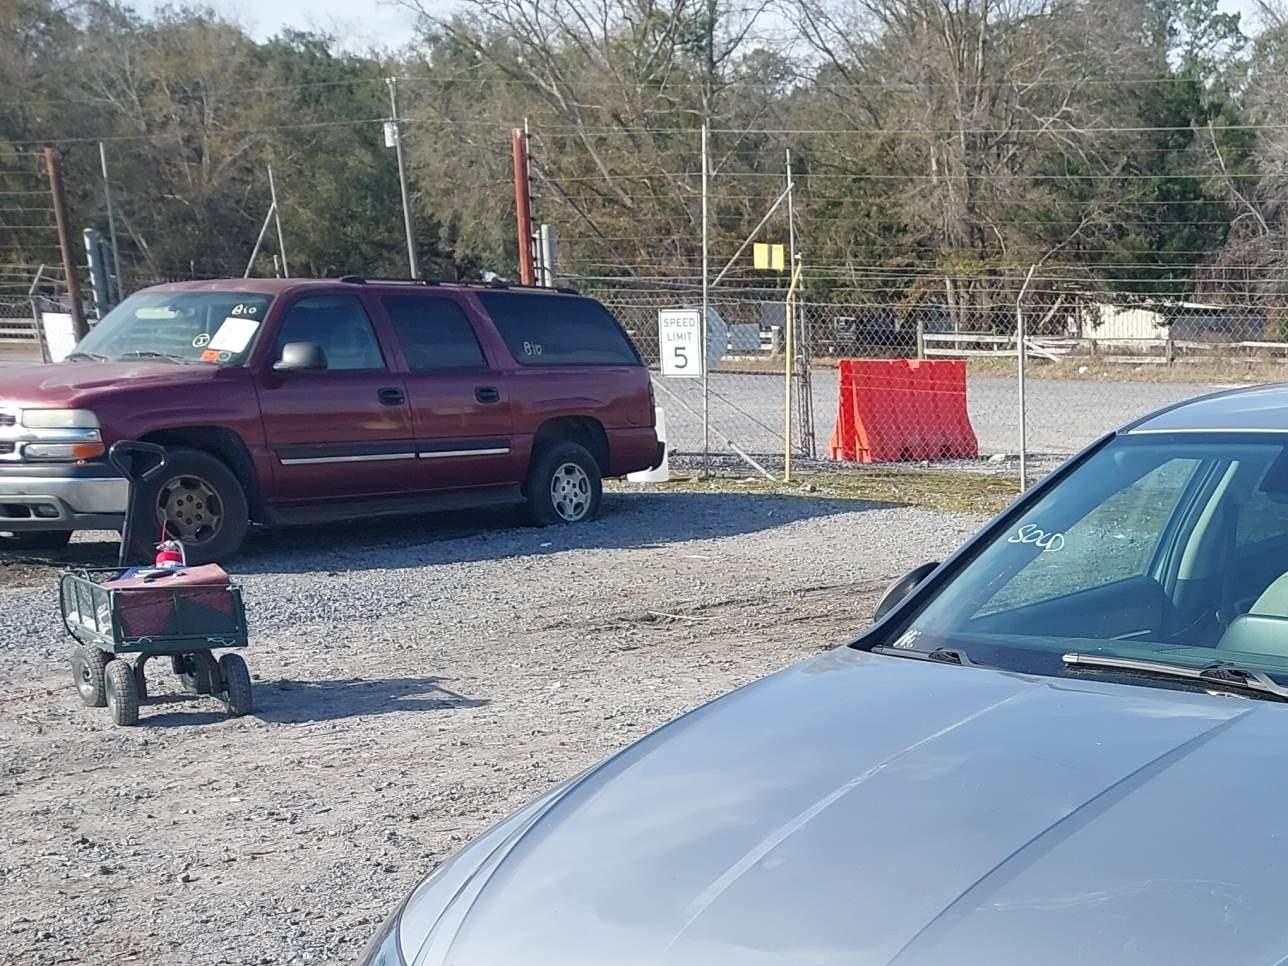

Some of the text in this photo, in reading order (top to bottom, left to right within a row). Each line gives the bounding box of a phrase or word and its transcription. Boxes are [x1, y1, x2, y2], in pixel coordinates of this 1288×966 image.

[663, 317, 696, 328] SPEED
[666, 331, 692, 342] LIMIT
[674, 346, 688, 369] 5
[1007, 523, 1065, 553] SOLD
